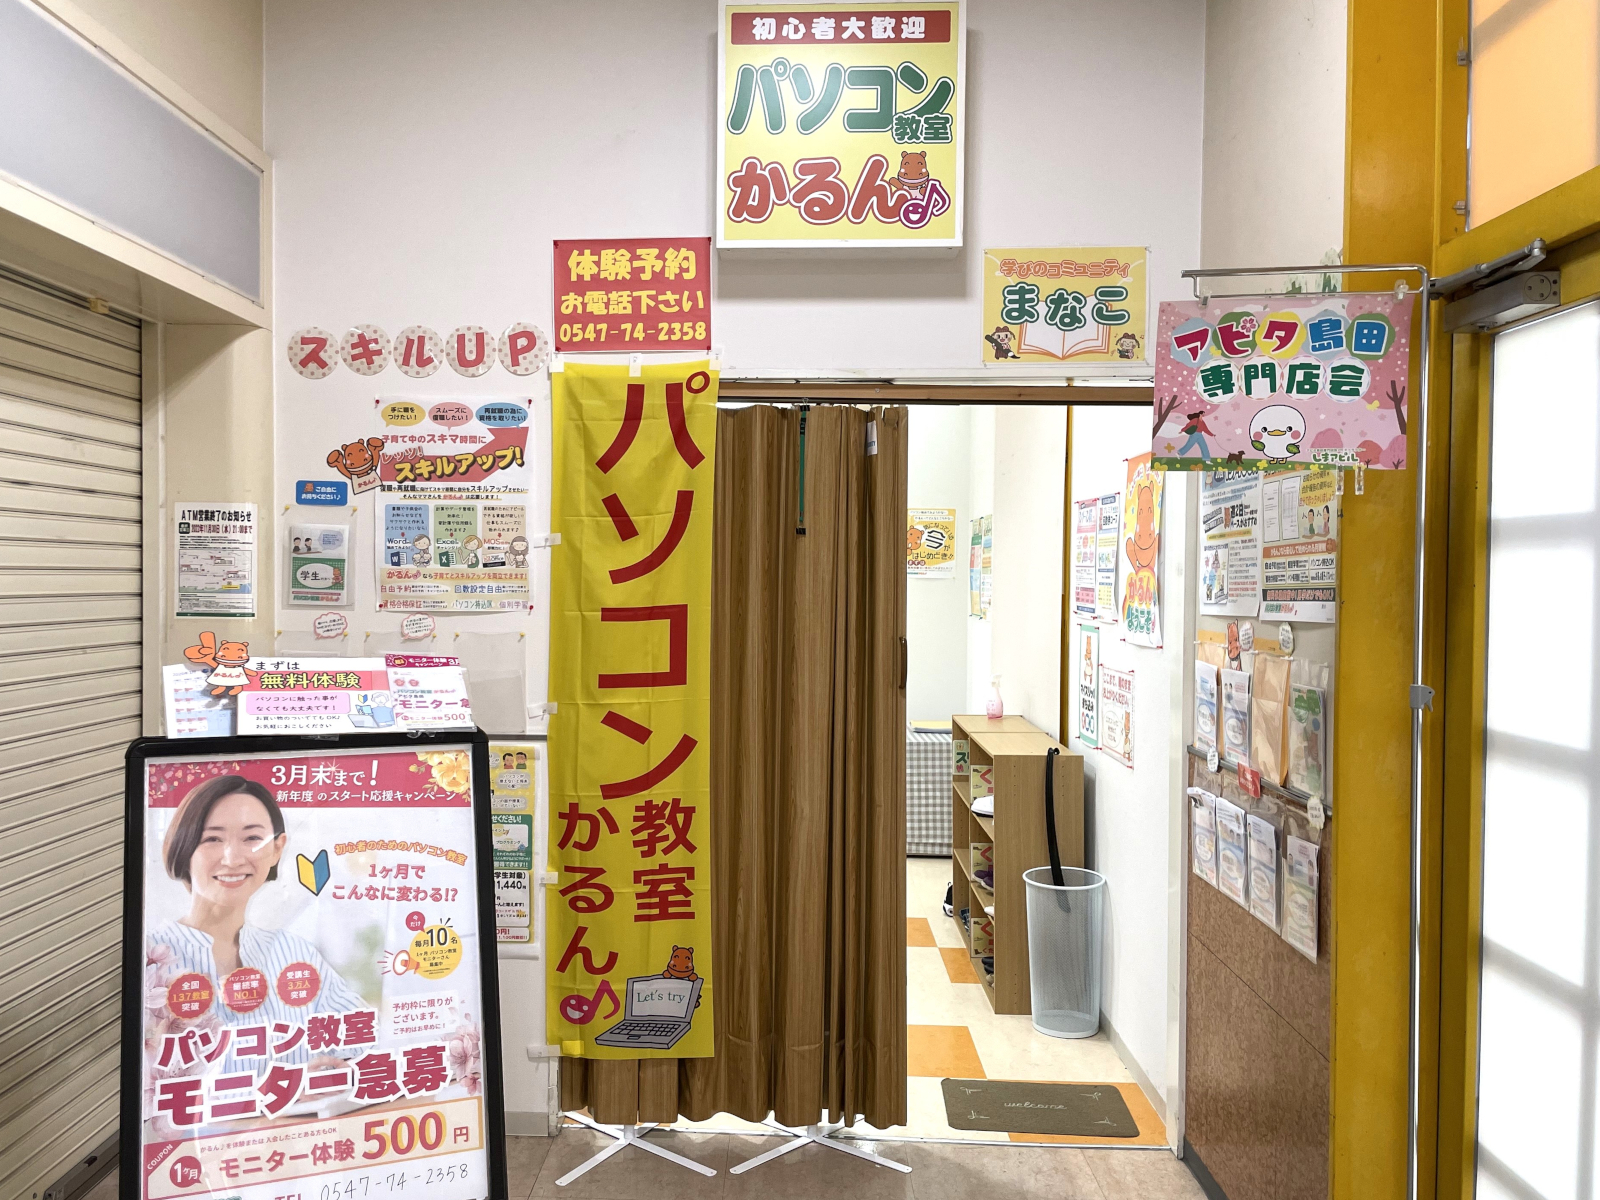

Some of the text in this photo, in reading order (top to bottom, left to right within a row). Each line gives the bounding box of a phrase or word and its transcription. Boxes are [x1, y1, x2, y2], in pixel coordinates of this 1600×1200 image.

[752, 16, 926, 40] 初心者大歓迎
[727, 57, 955, 135] パソコン
[892, 113, 953, 144] 教室
[727, 154, 912, 225] かるん
[568, 247, 697, 282] 体験予約
[1000, 258, 1131, 279] 学びのコミュニティ
[560, 290, 705, 316] お電話下さい
[1000, 281, 1131, 332] まなこ
[559, 321, 707, 342] 0547-74-2358
[1200, 361, 1365, 398] 専門店会
[390, 406, 416, 414] 手に職を
[382, 434, 487, 445] 子育て中のスキマ時間に
[381, 446, 424, 464] レッツ!
[394, 446, 525, 483] スキルアップ!
[440, 555, 447, 563] X
[380, 584, 412, 593] 自由予約
[454, 584, 502, 594] 回数設定自由
[595, 371, 710, 923] パソコン教室
[256, 661, 300, 671] まずは
[260, 672, 362, 689] 無料体験
[270, 759, 379, 787] 3月末まで!
[276, 789, 457, 803] 新年度 のスタート応援キャンペーン
[333, 839, 468, 867] 初心者のためのパソコン教室
[332, 884, 459, 903] こんなに変わる!?
[555, 802, 620, 976] かるん
[286, 970, 311, 980] 受講生
[287, 980, 311, 990] 3万人
[181, 980, 200, 991] 全国
[290, 990, 308, 999] 突破
[172, 990, 210, 1002] 137教室
[392, 996, 453, 1013] 予約枠に限りが
[637, 989, 686, 1004] Let's try
[181, 1002, 200, 1012] 突破
[393, 1011, 440, 1025] ございます。
[158, 1011, 376, 1068] パソコン教室
[157, 1045, 447, 1126] モニター急募
[1004, 1101, 1068, 1110] welcome
[219, 1111, 470, 1179] モニター体験 500 円
[146, 1143, 174, 1170] COUPON
[320, 1163, 469, 1200] 0547-74-2358
